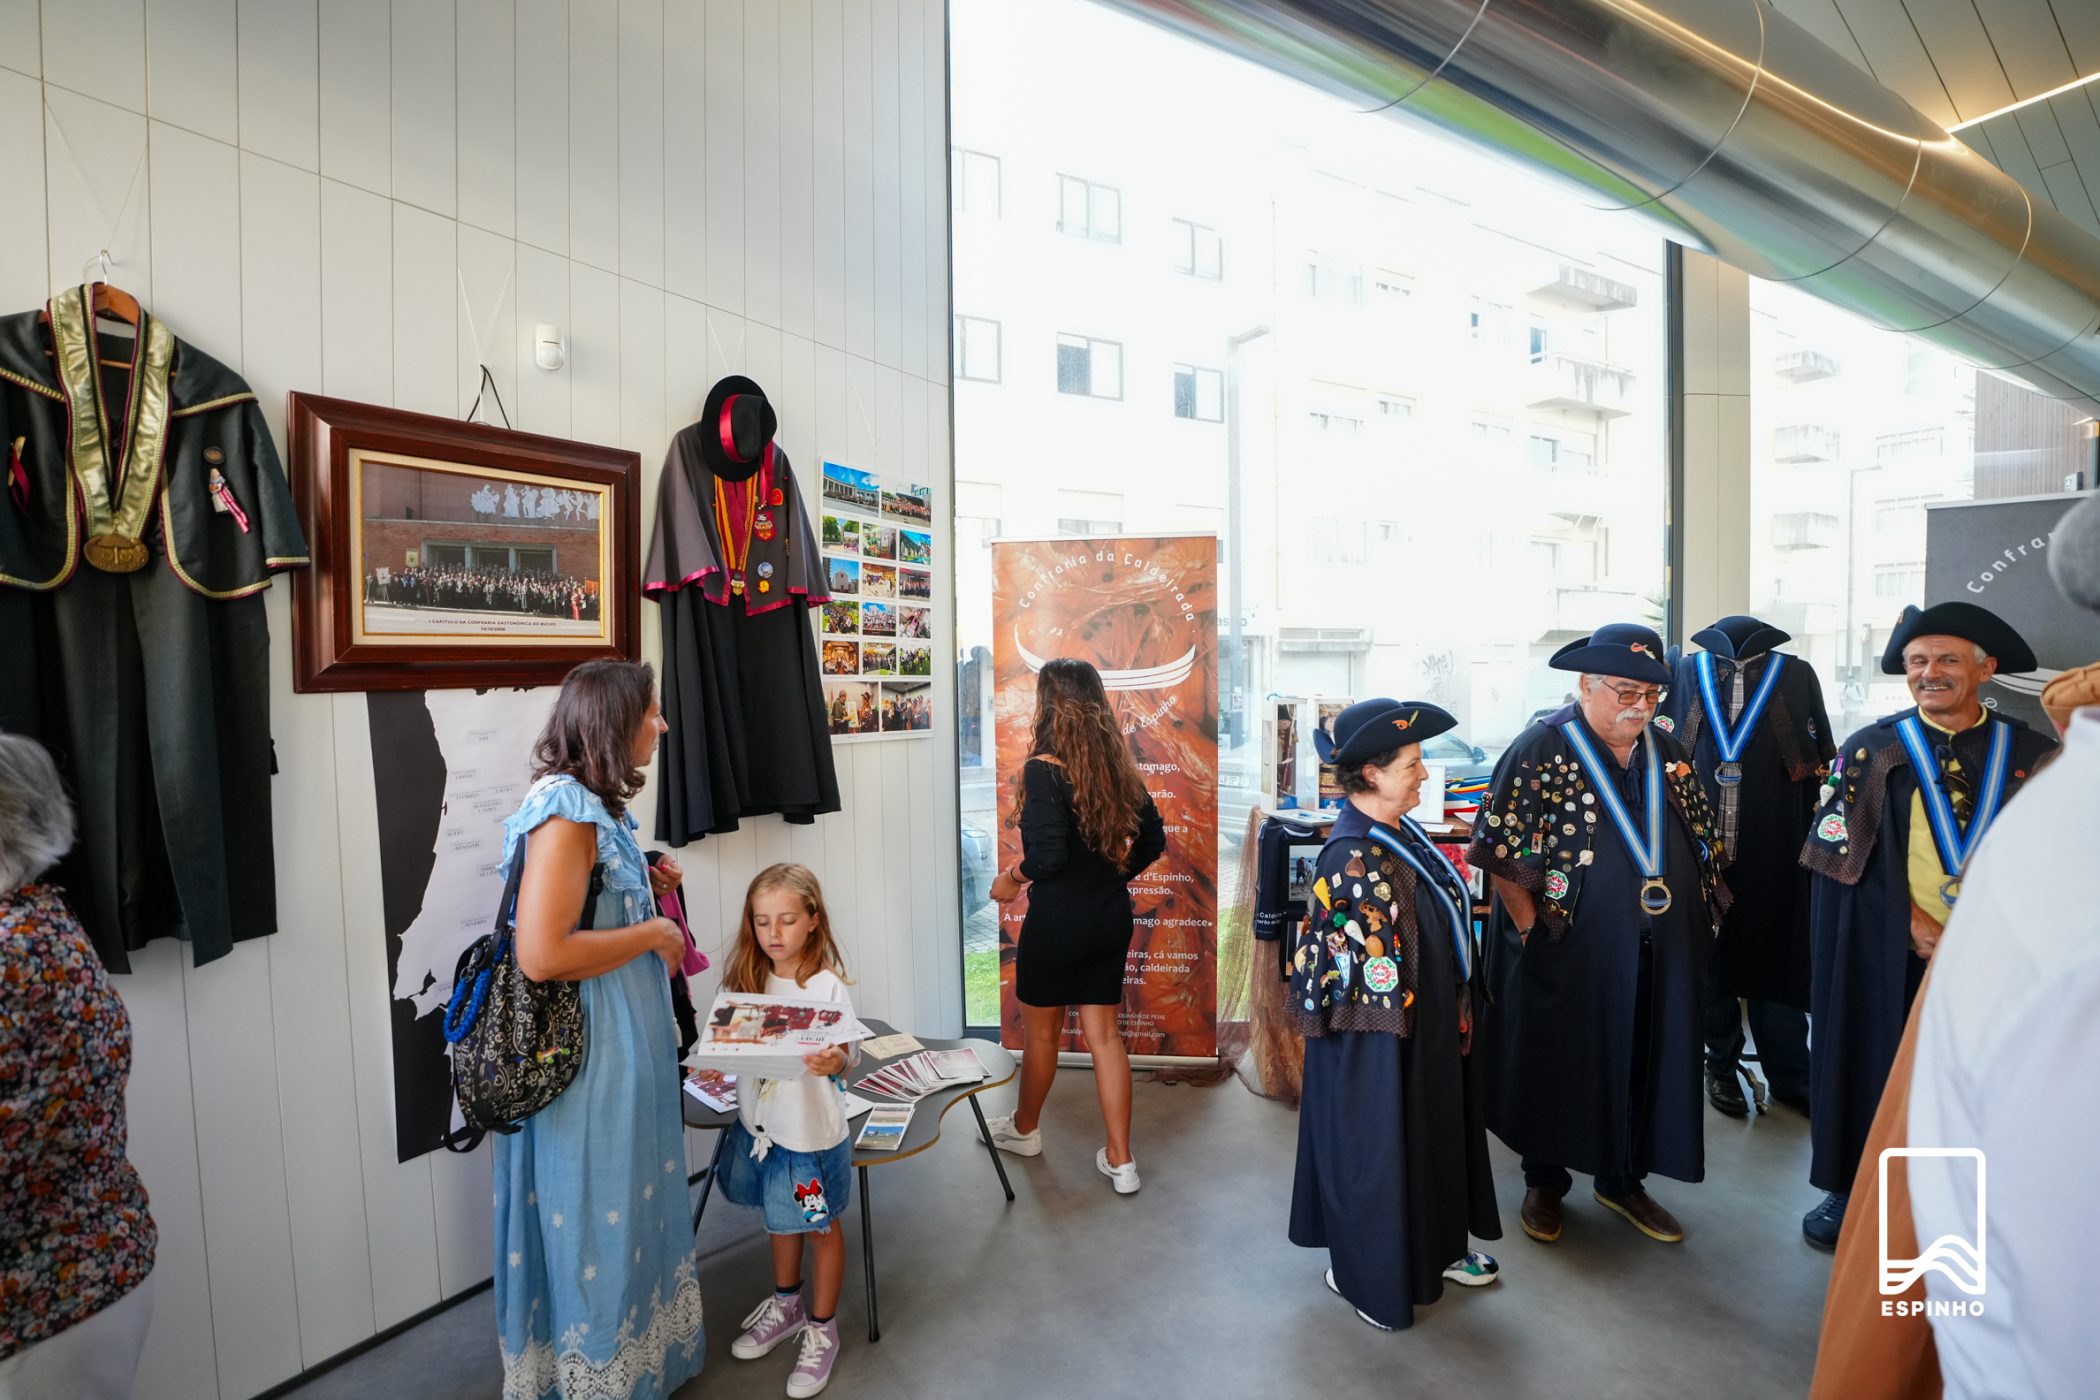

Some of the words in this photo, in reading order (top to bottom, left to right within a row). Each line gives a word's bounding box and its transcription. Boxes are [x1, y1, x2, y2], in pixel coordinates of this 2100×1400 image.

[1967, 532, 2053, 593] Confra
[1096, 550, 1115, 562] da
[1124, 553, 1194, 622] Caldeirada
[1122, 723, 1136, 735] de
[1141, 696, 1177, 728] Espinho
[1143, 872, 1194, 883] d'Espinho,
[1004, 913, 1011, 921] A
[1163, 917, 1212, 928] agradece.
[1153, 950, 1165, 959] cá
[1167, 952, 1198, 960] vamos
[1140, 963, 1190, 973] caldeirada
